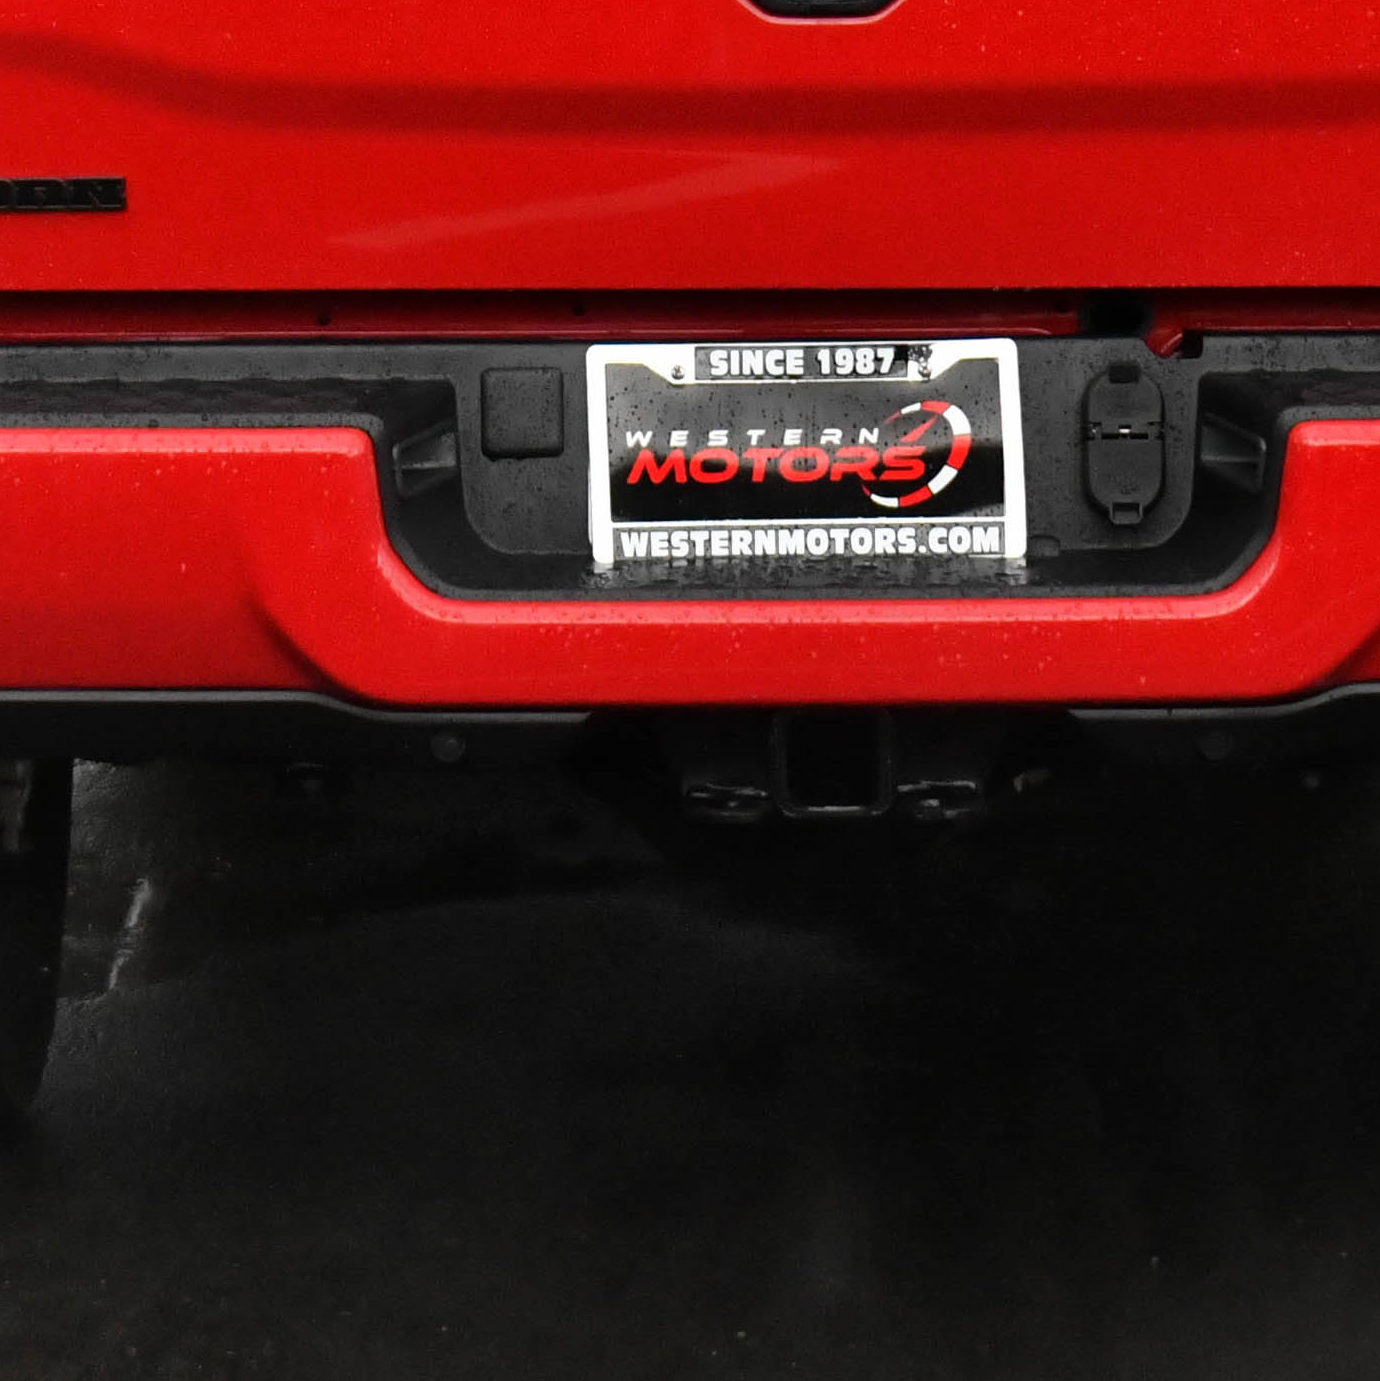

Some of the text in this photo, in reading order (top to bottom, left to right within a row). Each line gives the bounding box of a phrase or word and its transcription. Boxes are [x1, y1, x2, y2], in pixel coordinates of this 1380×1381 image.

[709, 347, 896, 376] SINCE 1987
[625, 427, 880, 448] WESTERN
[627, 445, 926, 484] MOTORS
[620, 526, 1000, 558] WESTERNMOTORS.COM
